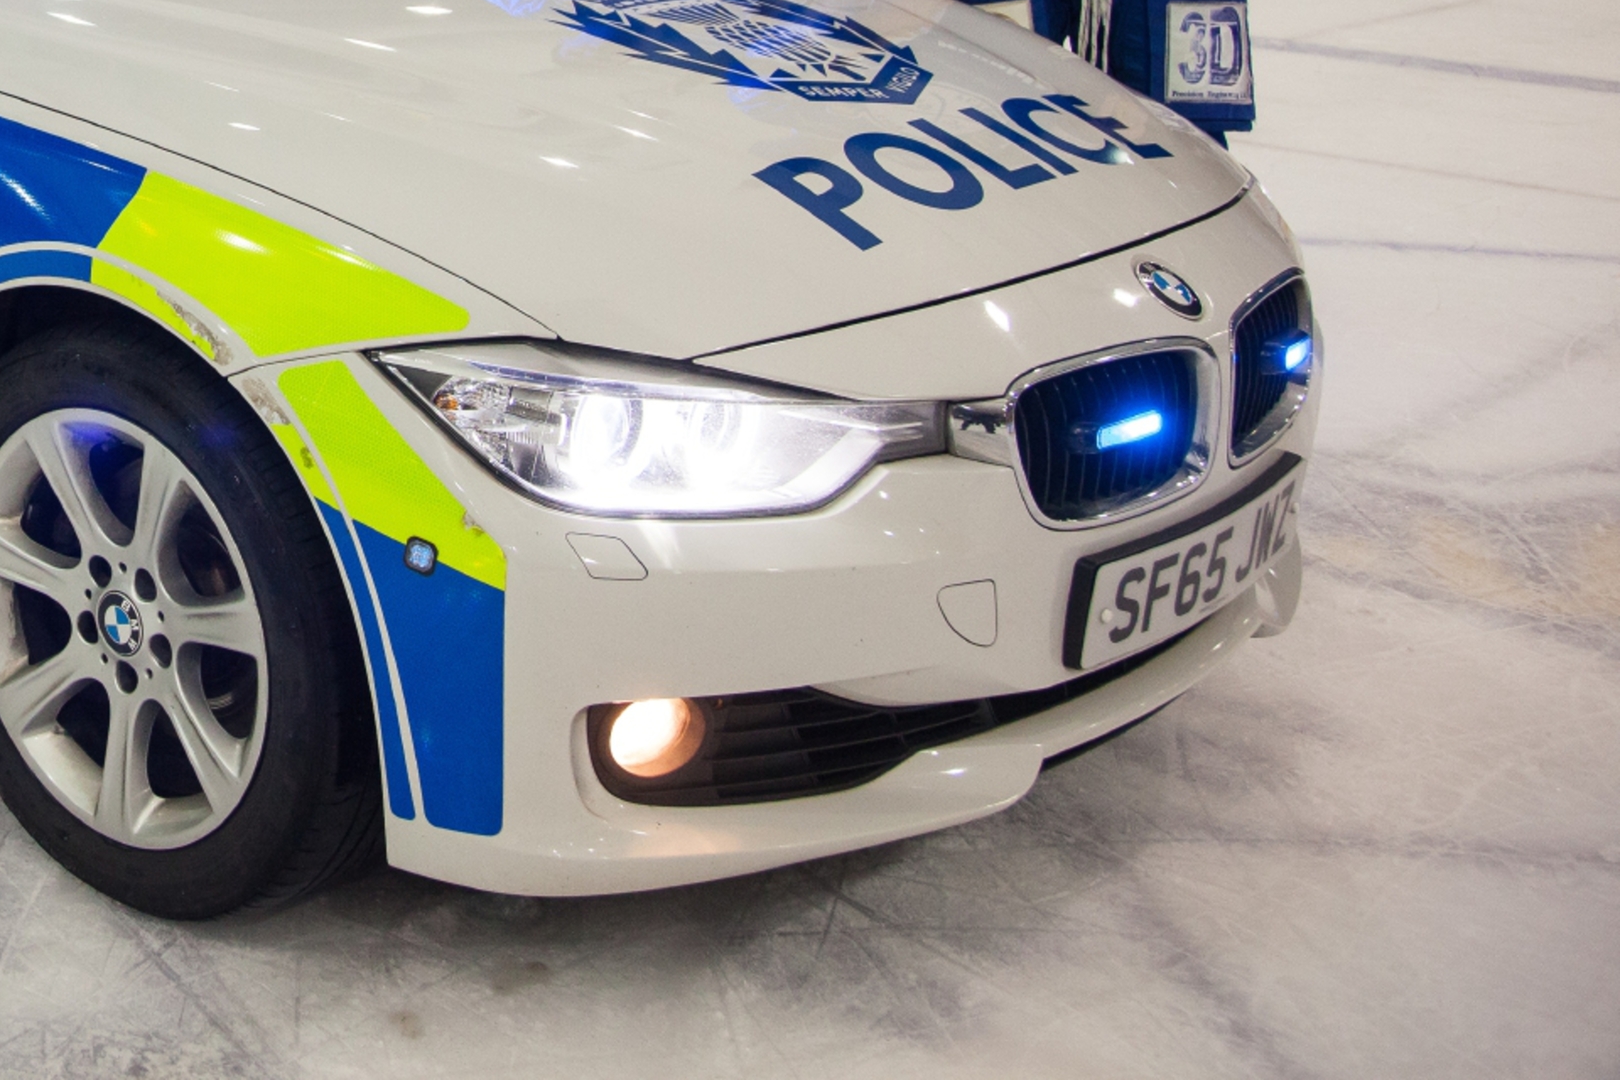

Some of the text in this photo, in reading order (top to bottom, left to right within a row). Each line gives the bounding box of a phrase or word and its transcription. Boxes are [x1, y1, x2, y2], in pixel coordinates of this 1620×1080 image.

[798, 85, 890, 99] SEMPER
[1178, 6, 1243, 86] 3D
[753, 94, 1175, 252] POLICE
[1108, 525, 1234, 644] SF65
